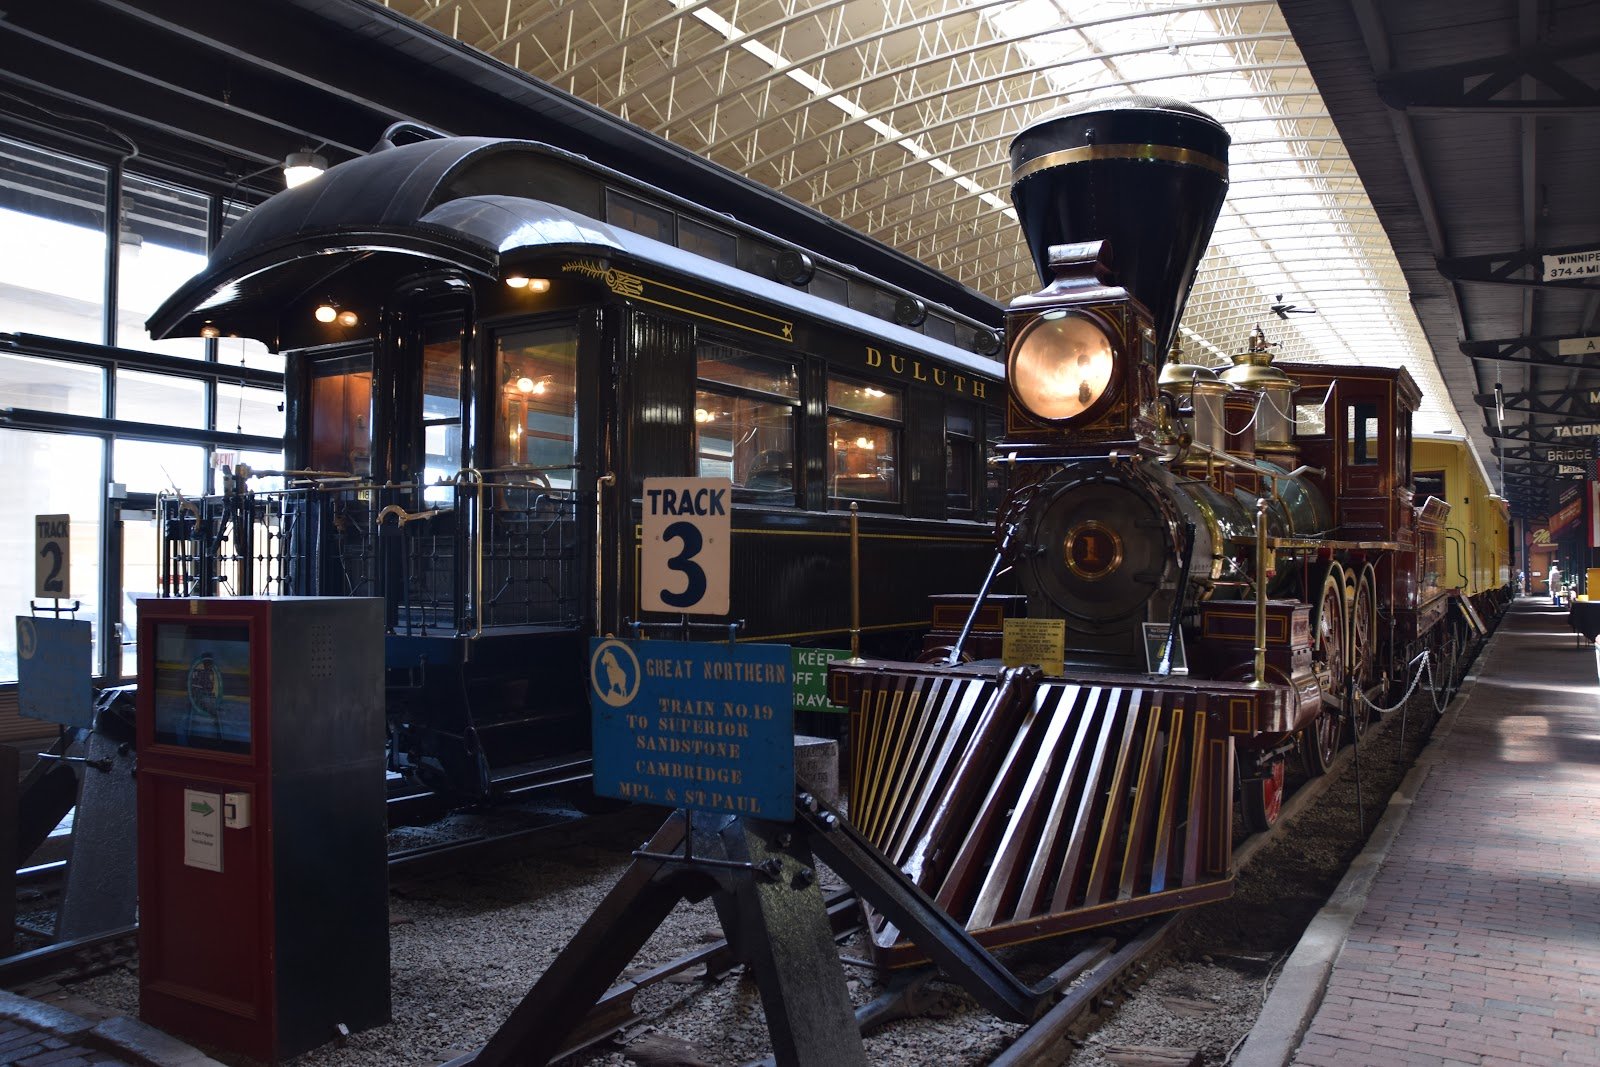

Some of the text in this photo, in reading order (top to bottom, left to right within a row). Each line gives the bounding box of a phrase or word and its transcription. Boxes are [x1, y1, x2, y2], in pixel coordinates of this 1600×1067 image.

[1550, 266, 1584, 277] 374.4
[866, 346, 986, 398] DULUTH
[1548, 450, 1592, 461] BRIDGE
[647, 488, 726, 516] TRACK
[37, 521, 69, 538] TRACK
[1082, 537, 1098, 560] 1
[40, 542, 64, 592] 2
[660, 521, 707, 608] 3
[798, 652, 834, 666] KEEP
[646, 659, 785, 684] GREAT NORTHERN
[658, 698, 714, 716] TRAIN
[626, 714, 748, 738] TO SUPERIOR
[636, 736, 740, 758] SANDSTONE
[636, 760, 742, 784] CAMBRIDGE
[666, 787, 676, 801] &
